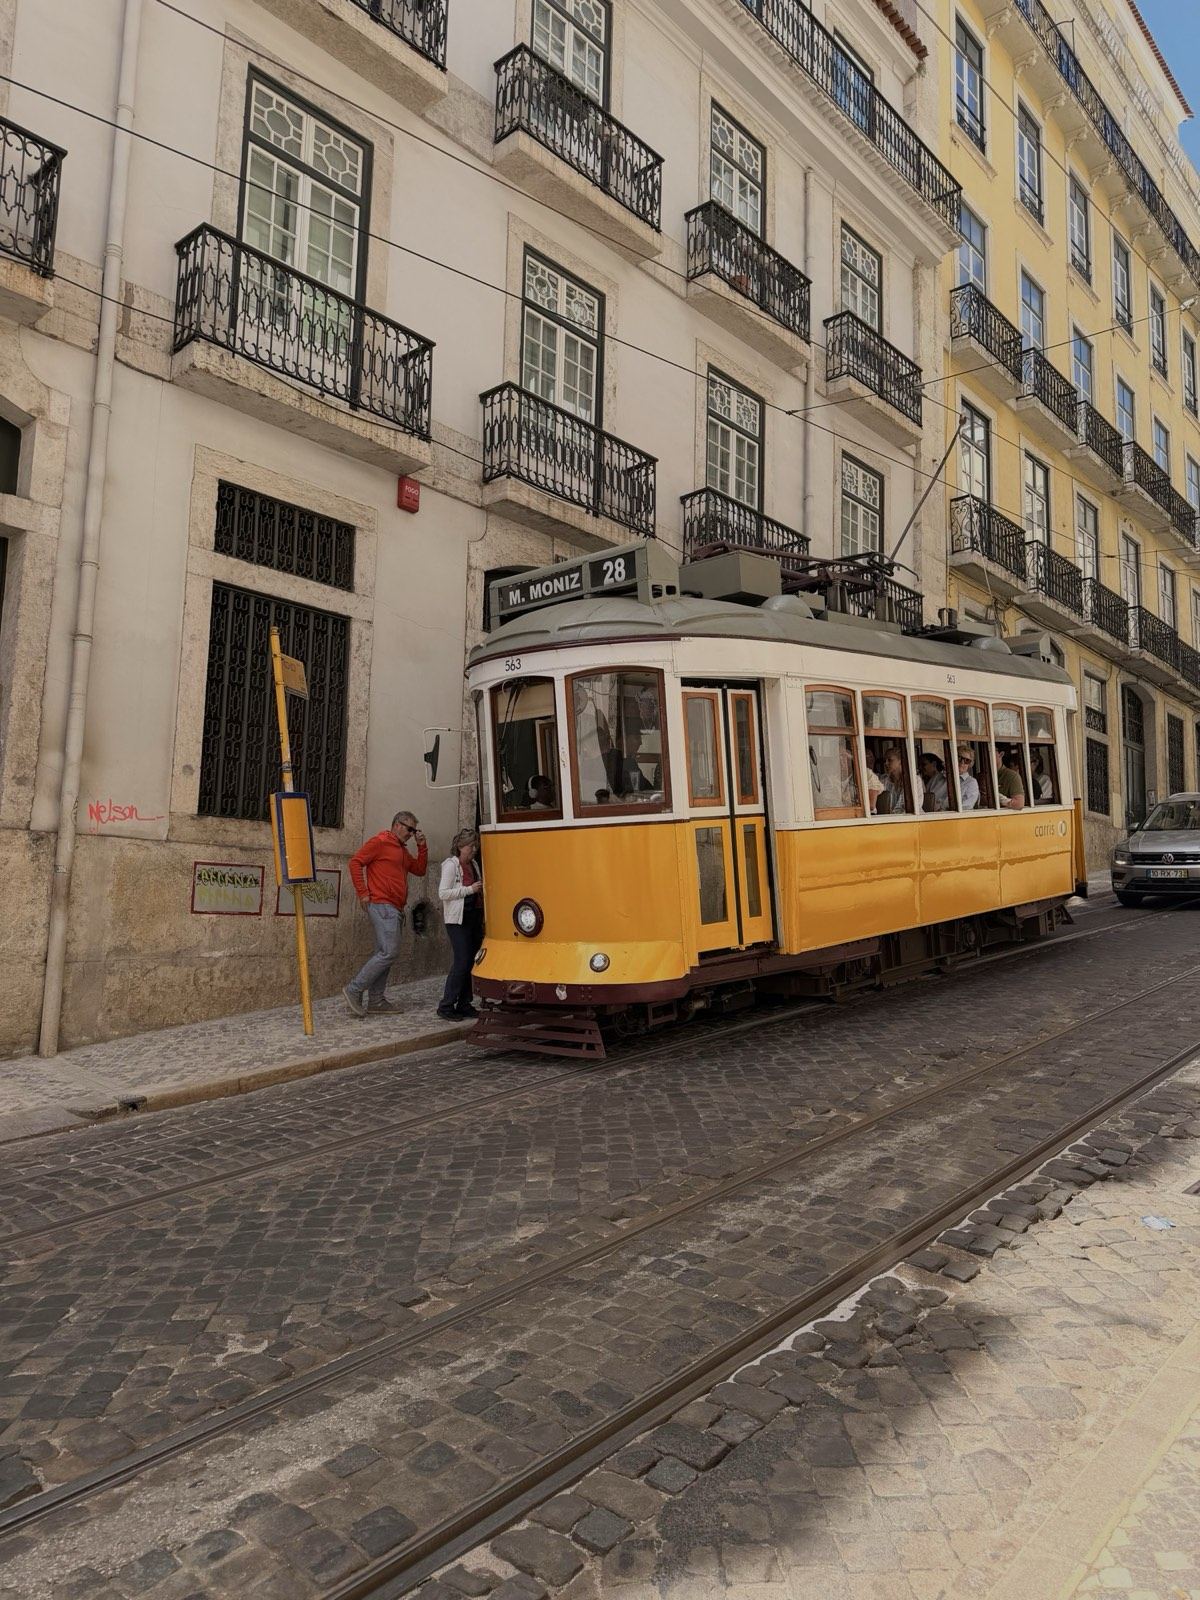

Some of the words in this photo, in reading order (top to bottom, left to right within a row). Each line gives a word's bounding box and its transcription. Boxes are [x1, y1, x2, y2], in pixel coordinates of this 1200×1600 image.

[405, 484, 419, 496] FOGO
[602, 557, 626, 586] 28
[509, 589, 526, 606] M.
[529, 572, 581, 600] MONIZ
[505, 658, 522, 672] 563
[946, 673, 956, 684] 563
[1035, 819, 1055, 837] carris
